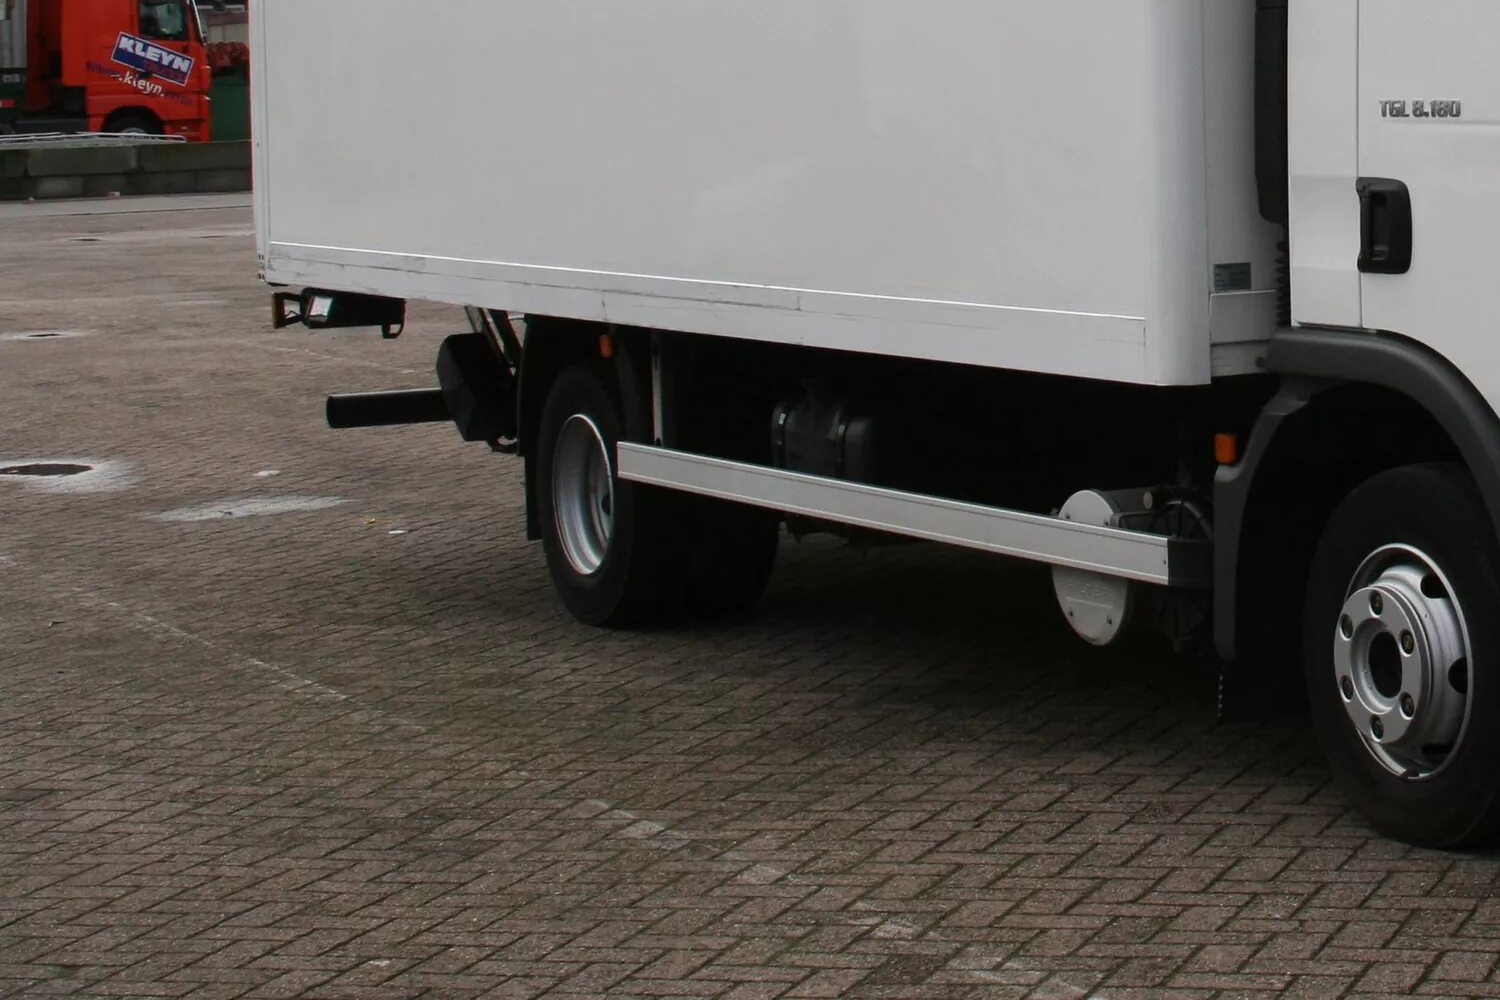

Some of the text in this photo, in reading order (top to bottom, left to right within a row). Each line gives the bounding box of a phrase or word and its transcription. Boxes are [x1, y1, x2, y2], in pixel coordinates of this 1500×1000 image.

[118, 36, 191, 73] KLEYN
[1379, 100, 1461, 117] TGL 8.180
